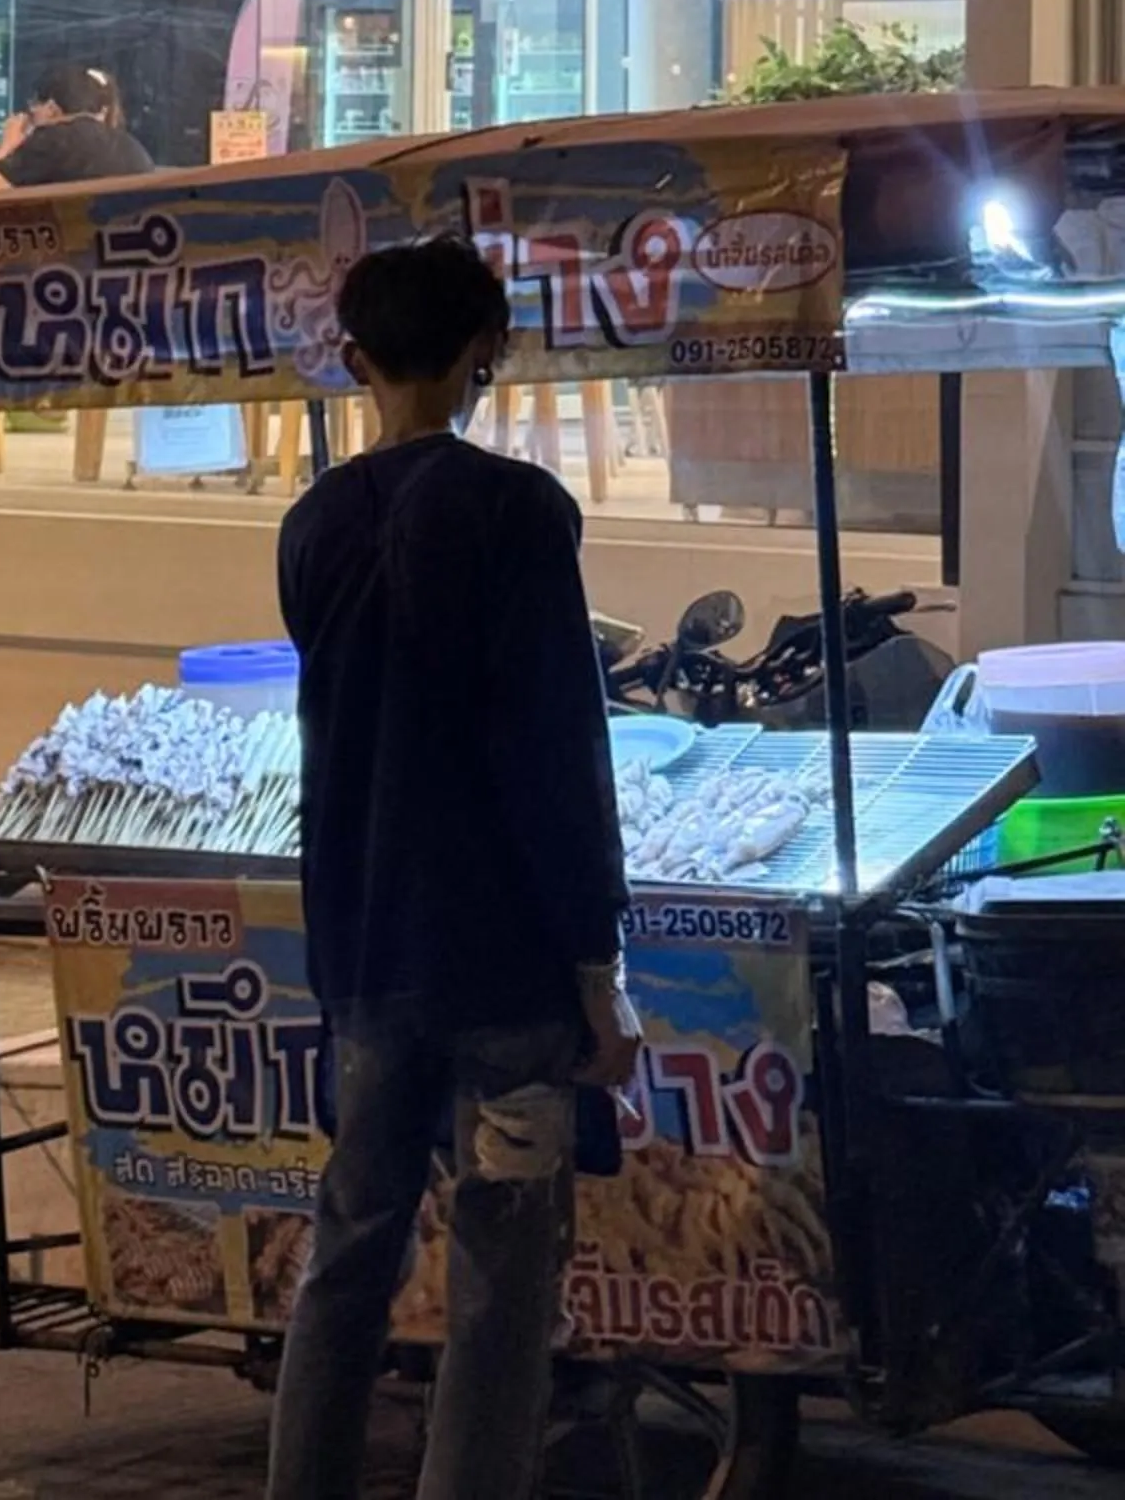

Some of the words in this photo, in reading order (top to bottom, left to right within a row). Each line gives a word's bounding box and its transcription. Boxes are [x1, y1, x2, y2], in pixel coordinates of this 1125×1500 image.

[671, 335, 831, 363] 091-2505872
[50, 883, 233, 945] พริ้มพราว
[620, 906, 790, 941] 91-2505872
